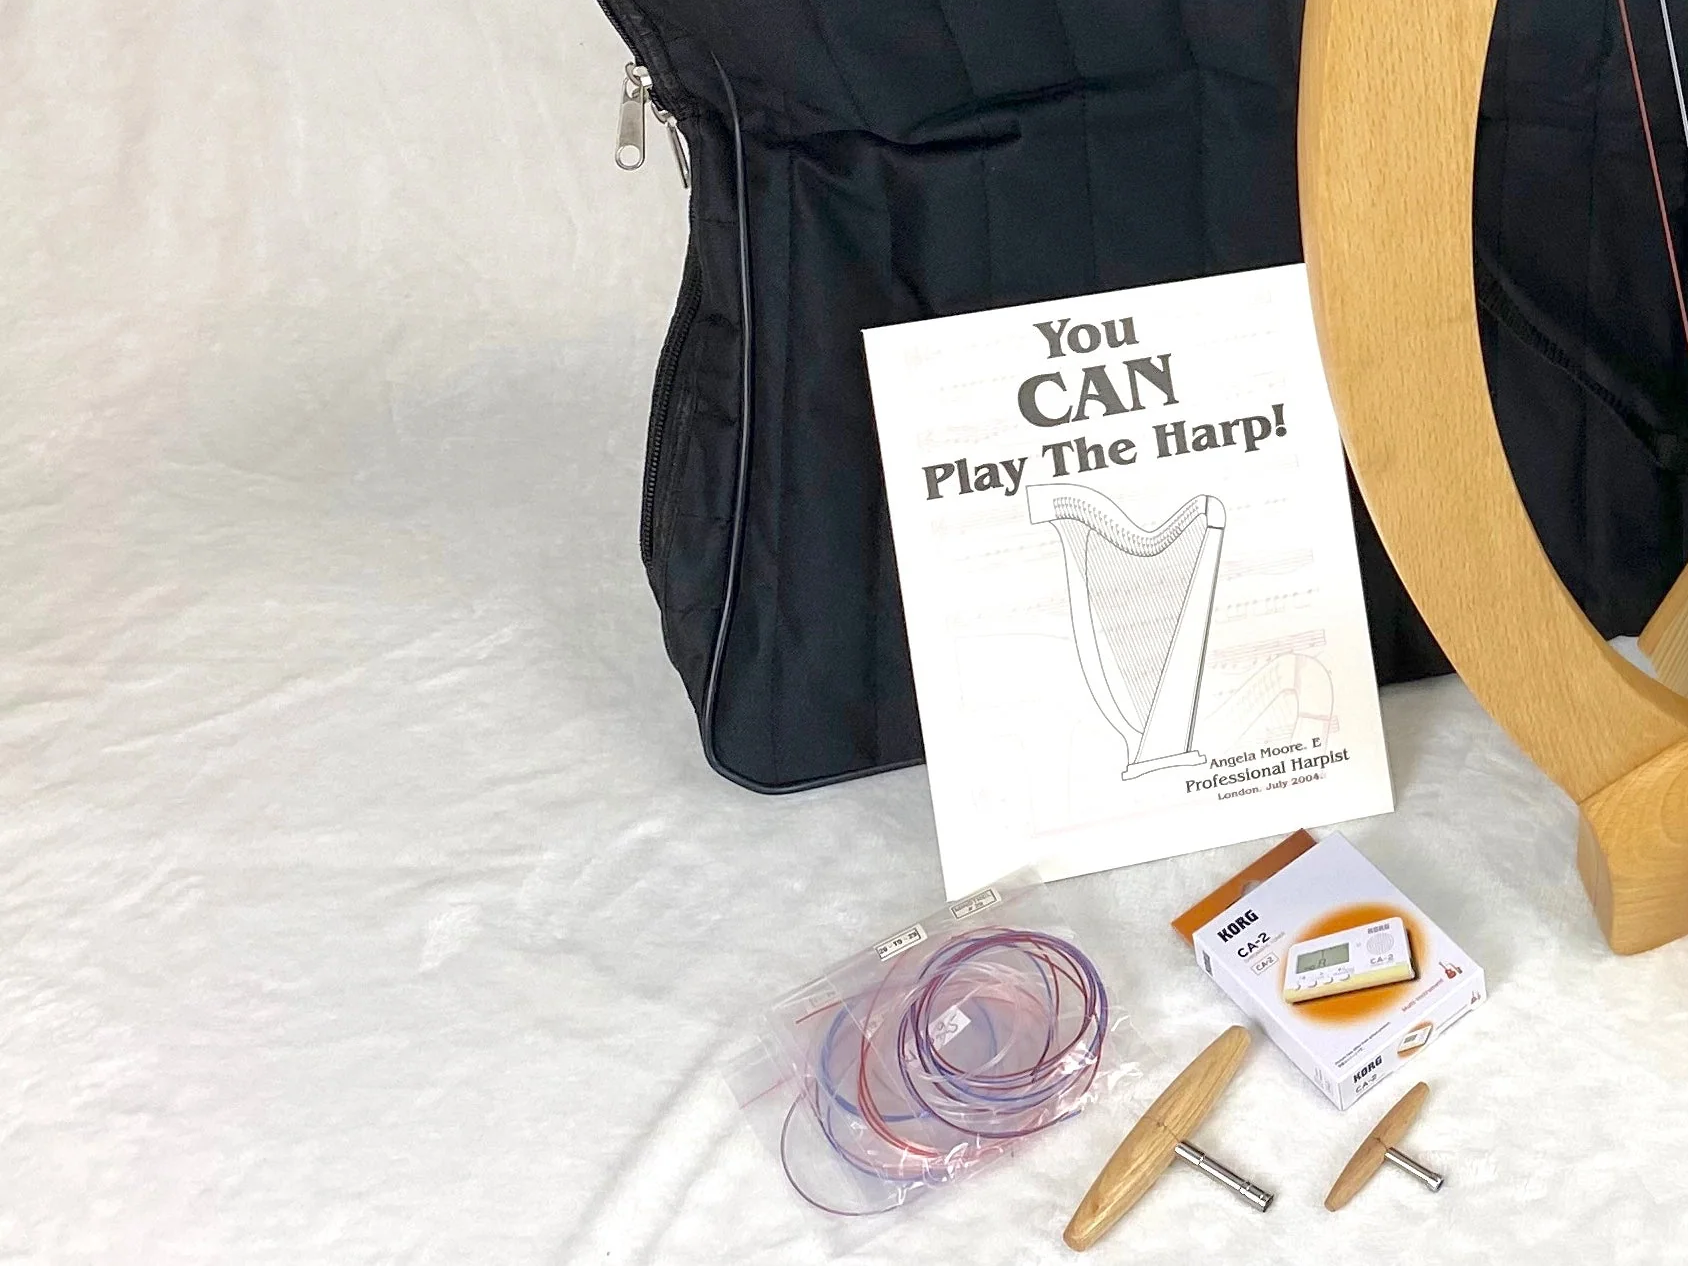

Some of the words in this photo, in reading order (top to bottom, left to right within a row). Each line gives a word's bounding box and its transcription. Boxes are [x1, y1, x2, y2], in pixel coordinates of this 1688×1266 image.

[1033, 316, 1139, 359] You
[1018, 353, 1180, 428] CAN
[921, 456, 1028, 500] Play
[1041, 436, 1138, 477] The
[1152, 403, 1288, 458] Harp!
[1185, 761, 1286, 793] Professional
[1291, 748, 1351, 772] Harpist
[1209, 752, 1257, 769] Angela
[1265, 779, 1288, 792] July
[1217, 909, 1259, 943] KORG
[1237, 932, 1271, 958] CA-2
[1255, 956, 1274, 971] CA-2
[1353, 1055, 1382, 1083] KORG
